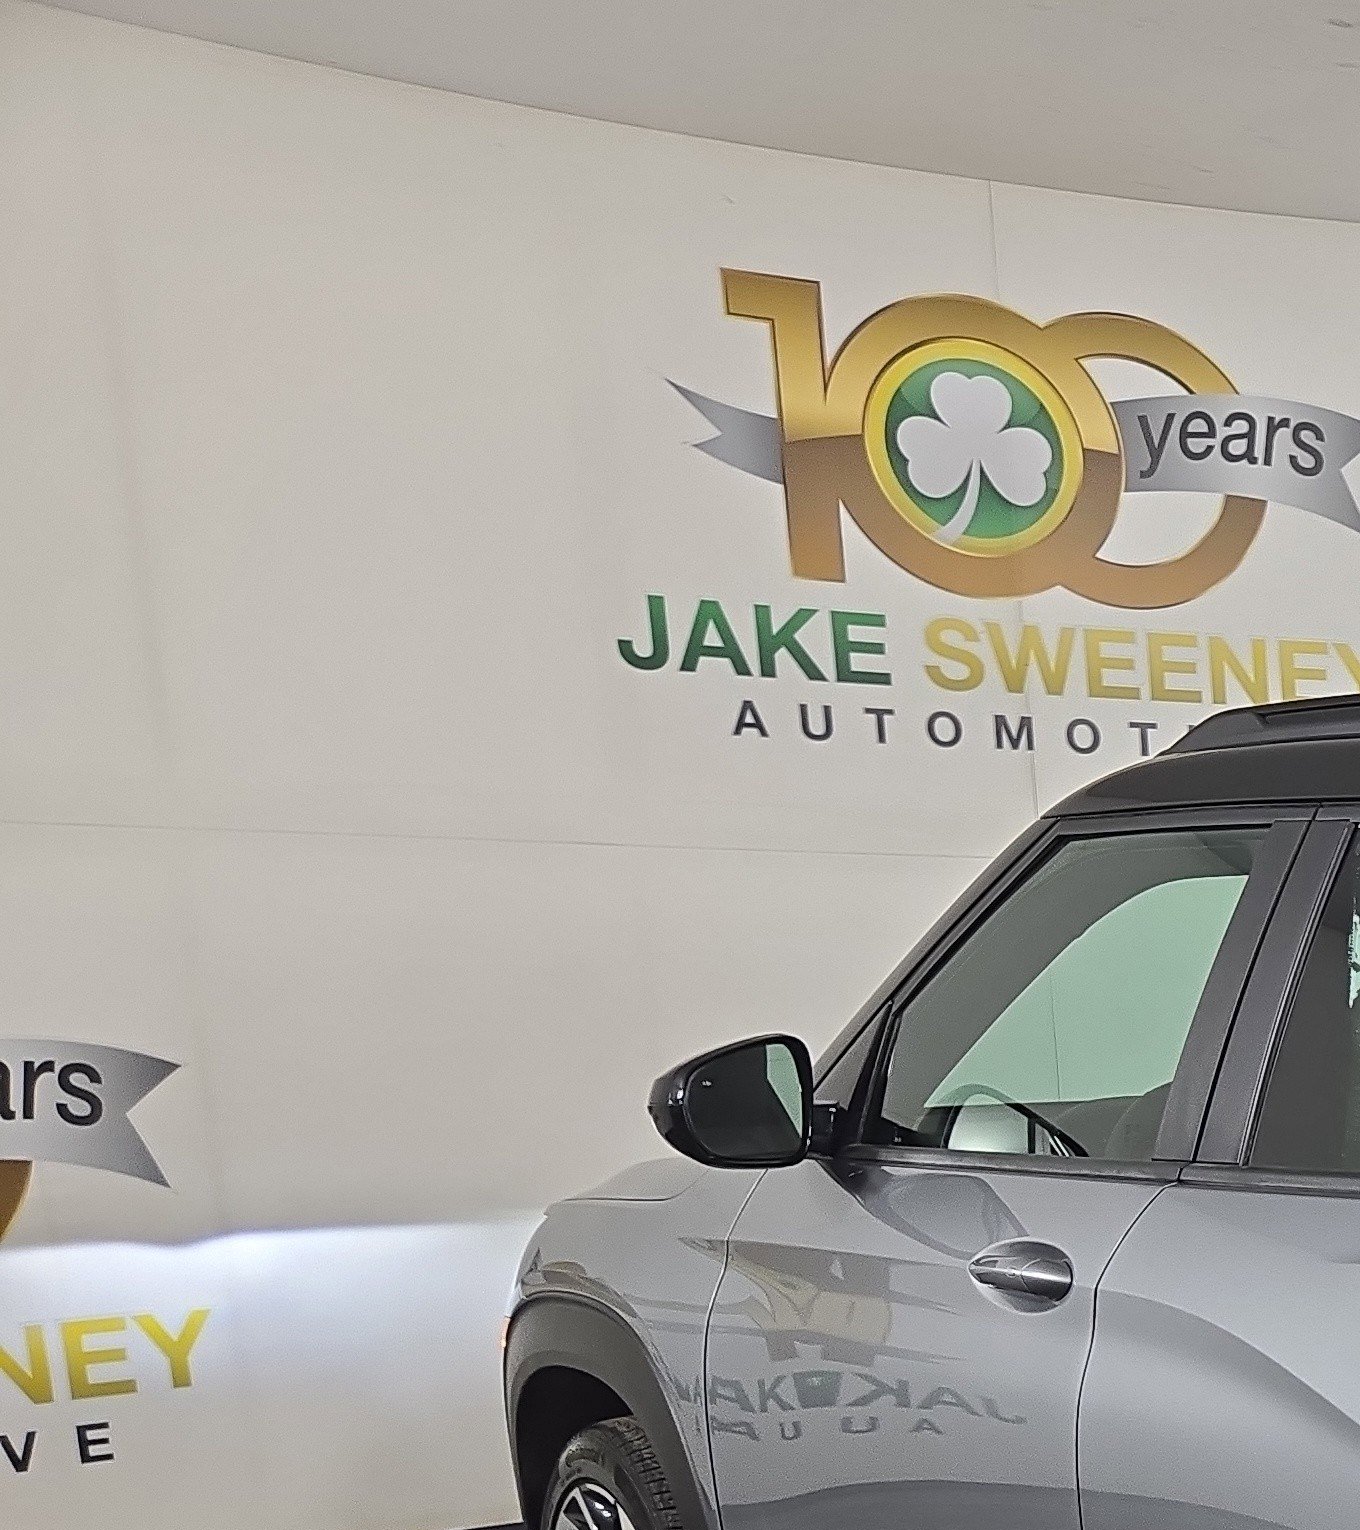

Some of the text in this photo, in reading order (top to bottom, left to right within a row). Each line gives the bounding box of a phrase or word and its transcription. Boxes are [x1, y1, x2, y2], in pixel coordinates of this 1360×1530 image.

[1137, 404, 1327, 482] years
[615, 593, 892, 686] JAKE
[733, 700, 1200, 757] AUTOMOT
